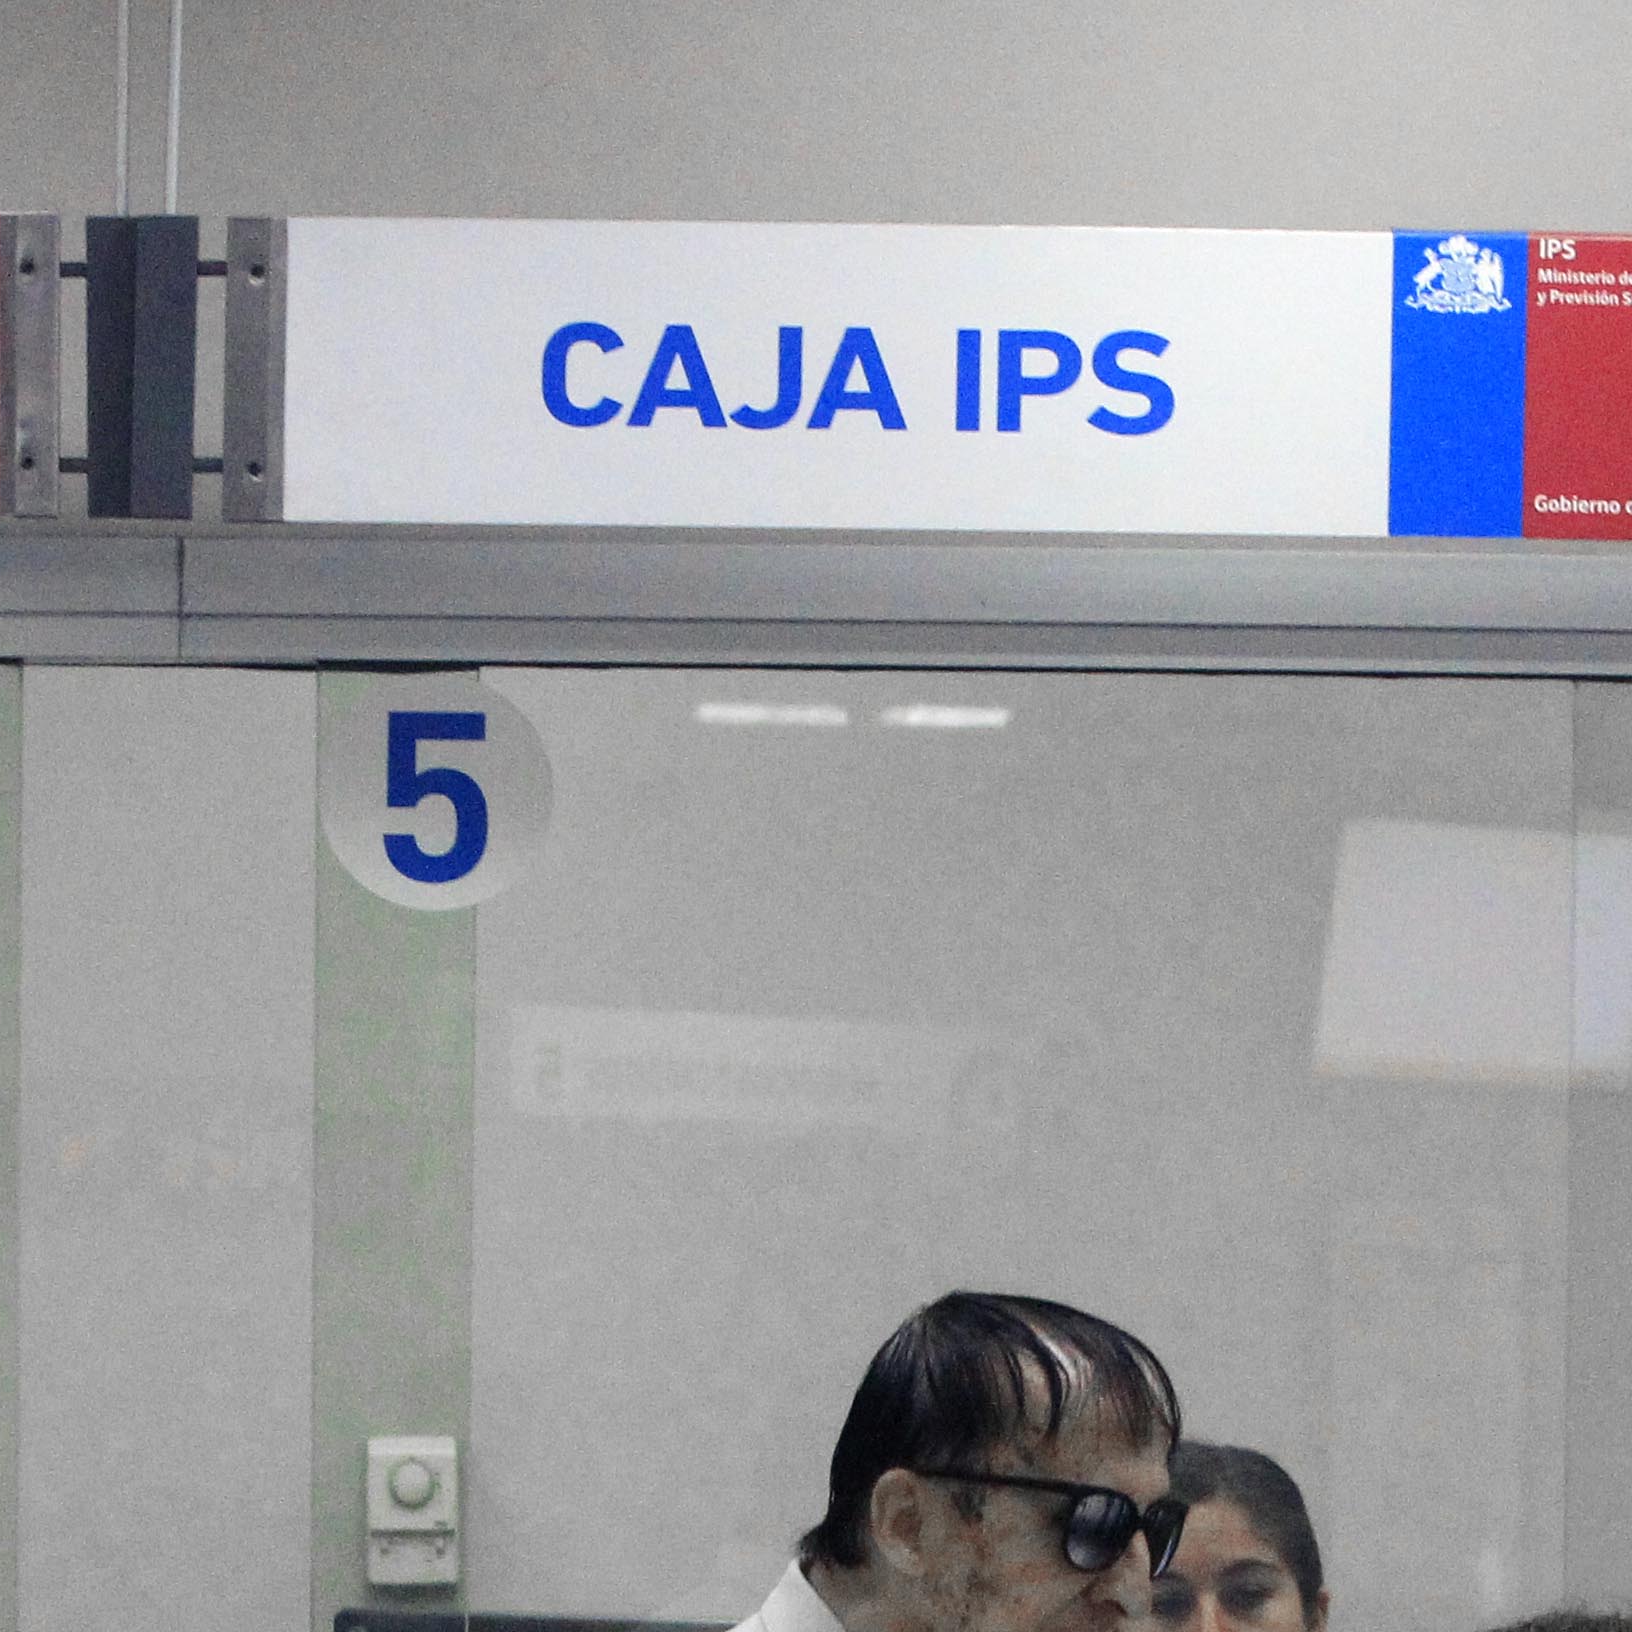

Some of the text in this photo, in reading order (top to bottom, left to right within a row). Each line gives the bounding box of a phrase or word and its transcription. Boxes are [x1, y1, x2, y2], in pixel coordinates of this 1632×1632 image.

[1539, 237, 1577, 260] IPS
[1537, 268, 1616, 286] Ministerio
[1536, 292, 1546, 307] y
[1549, 289, 1619, 306] Previsión
[543, 322, 1176, 437] CAJA IPS
[1533, 494, 1621, 514] Gobierno
[383, 711, 489, 884] 5
